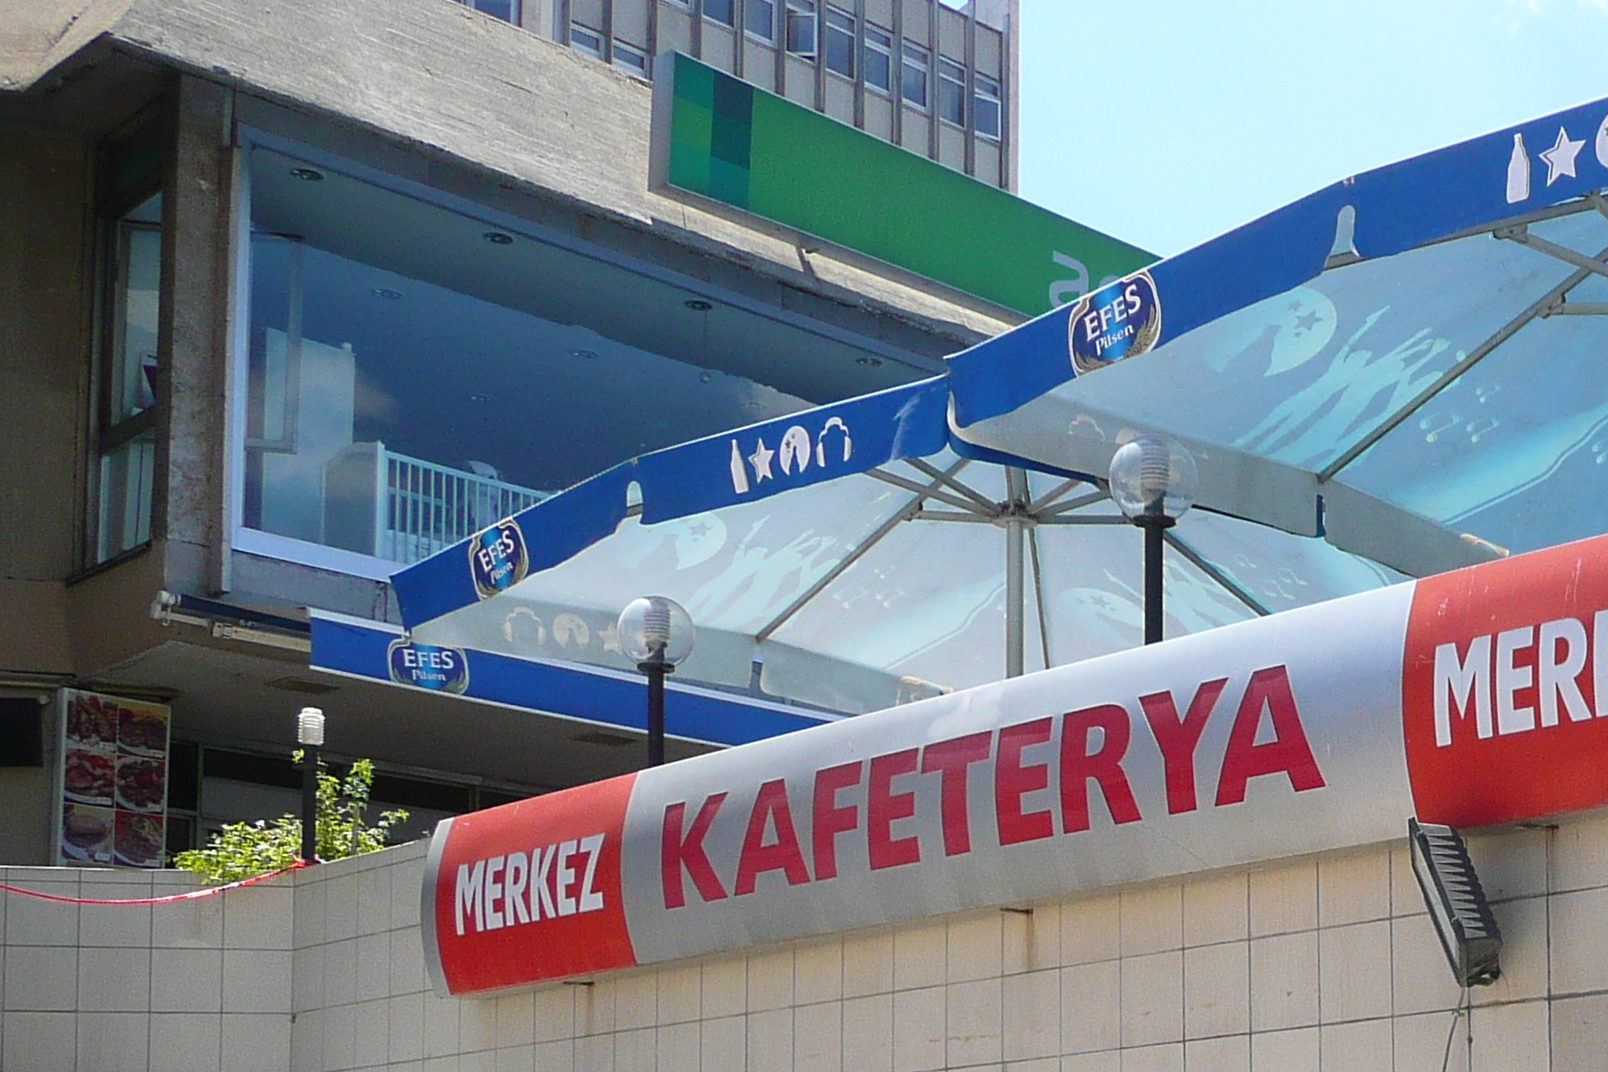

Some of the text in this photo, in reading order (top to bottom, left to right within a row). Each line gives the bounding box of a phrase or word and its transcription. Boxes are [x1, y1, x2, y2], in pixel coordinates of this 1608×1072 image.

[1083, 284, 1141, 341] EFES
[1095, 324, 1135, 356] Pilsen
[478, 530, 515, 572] EFES
[490, 561, 514, 584] Pilsen
[402, 649, 454, 669] EFES
[412, 669, 447, 681] Pilsen
[661, 664, 1328, 910] KAFETERYA
[454, 834, 604, 936] MERKEZ
